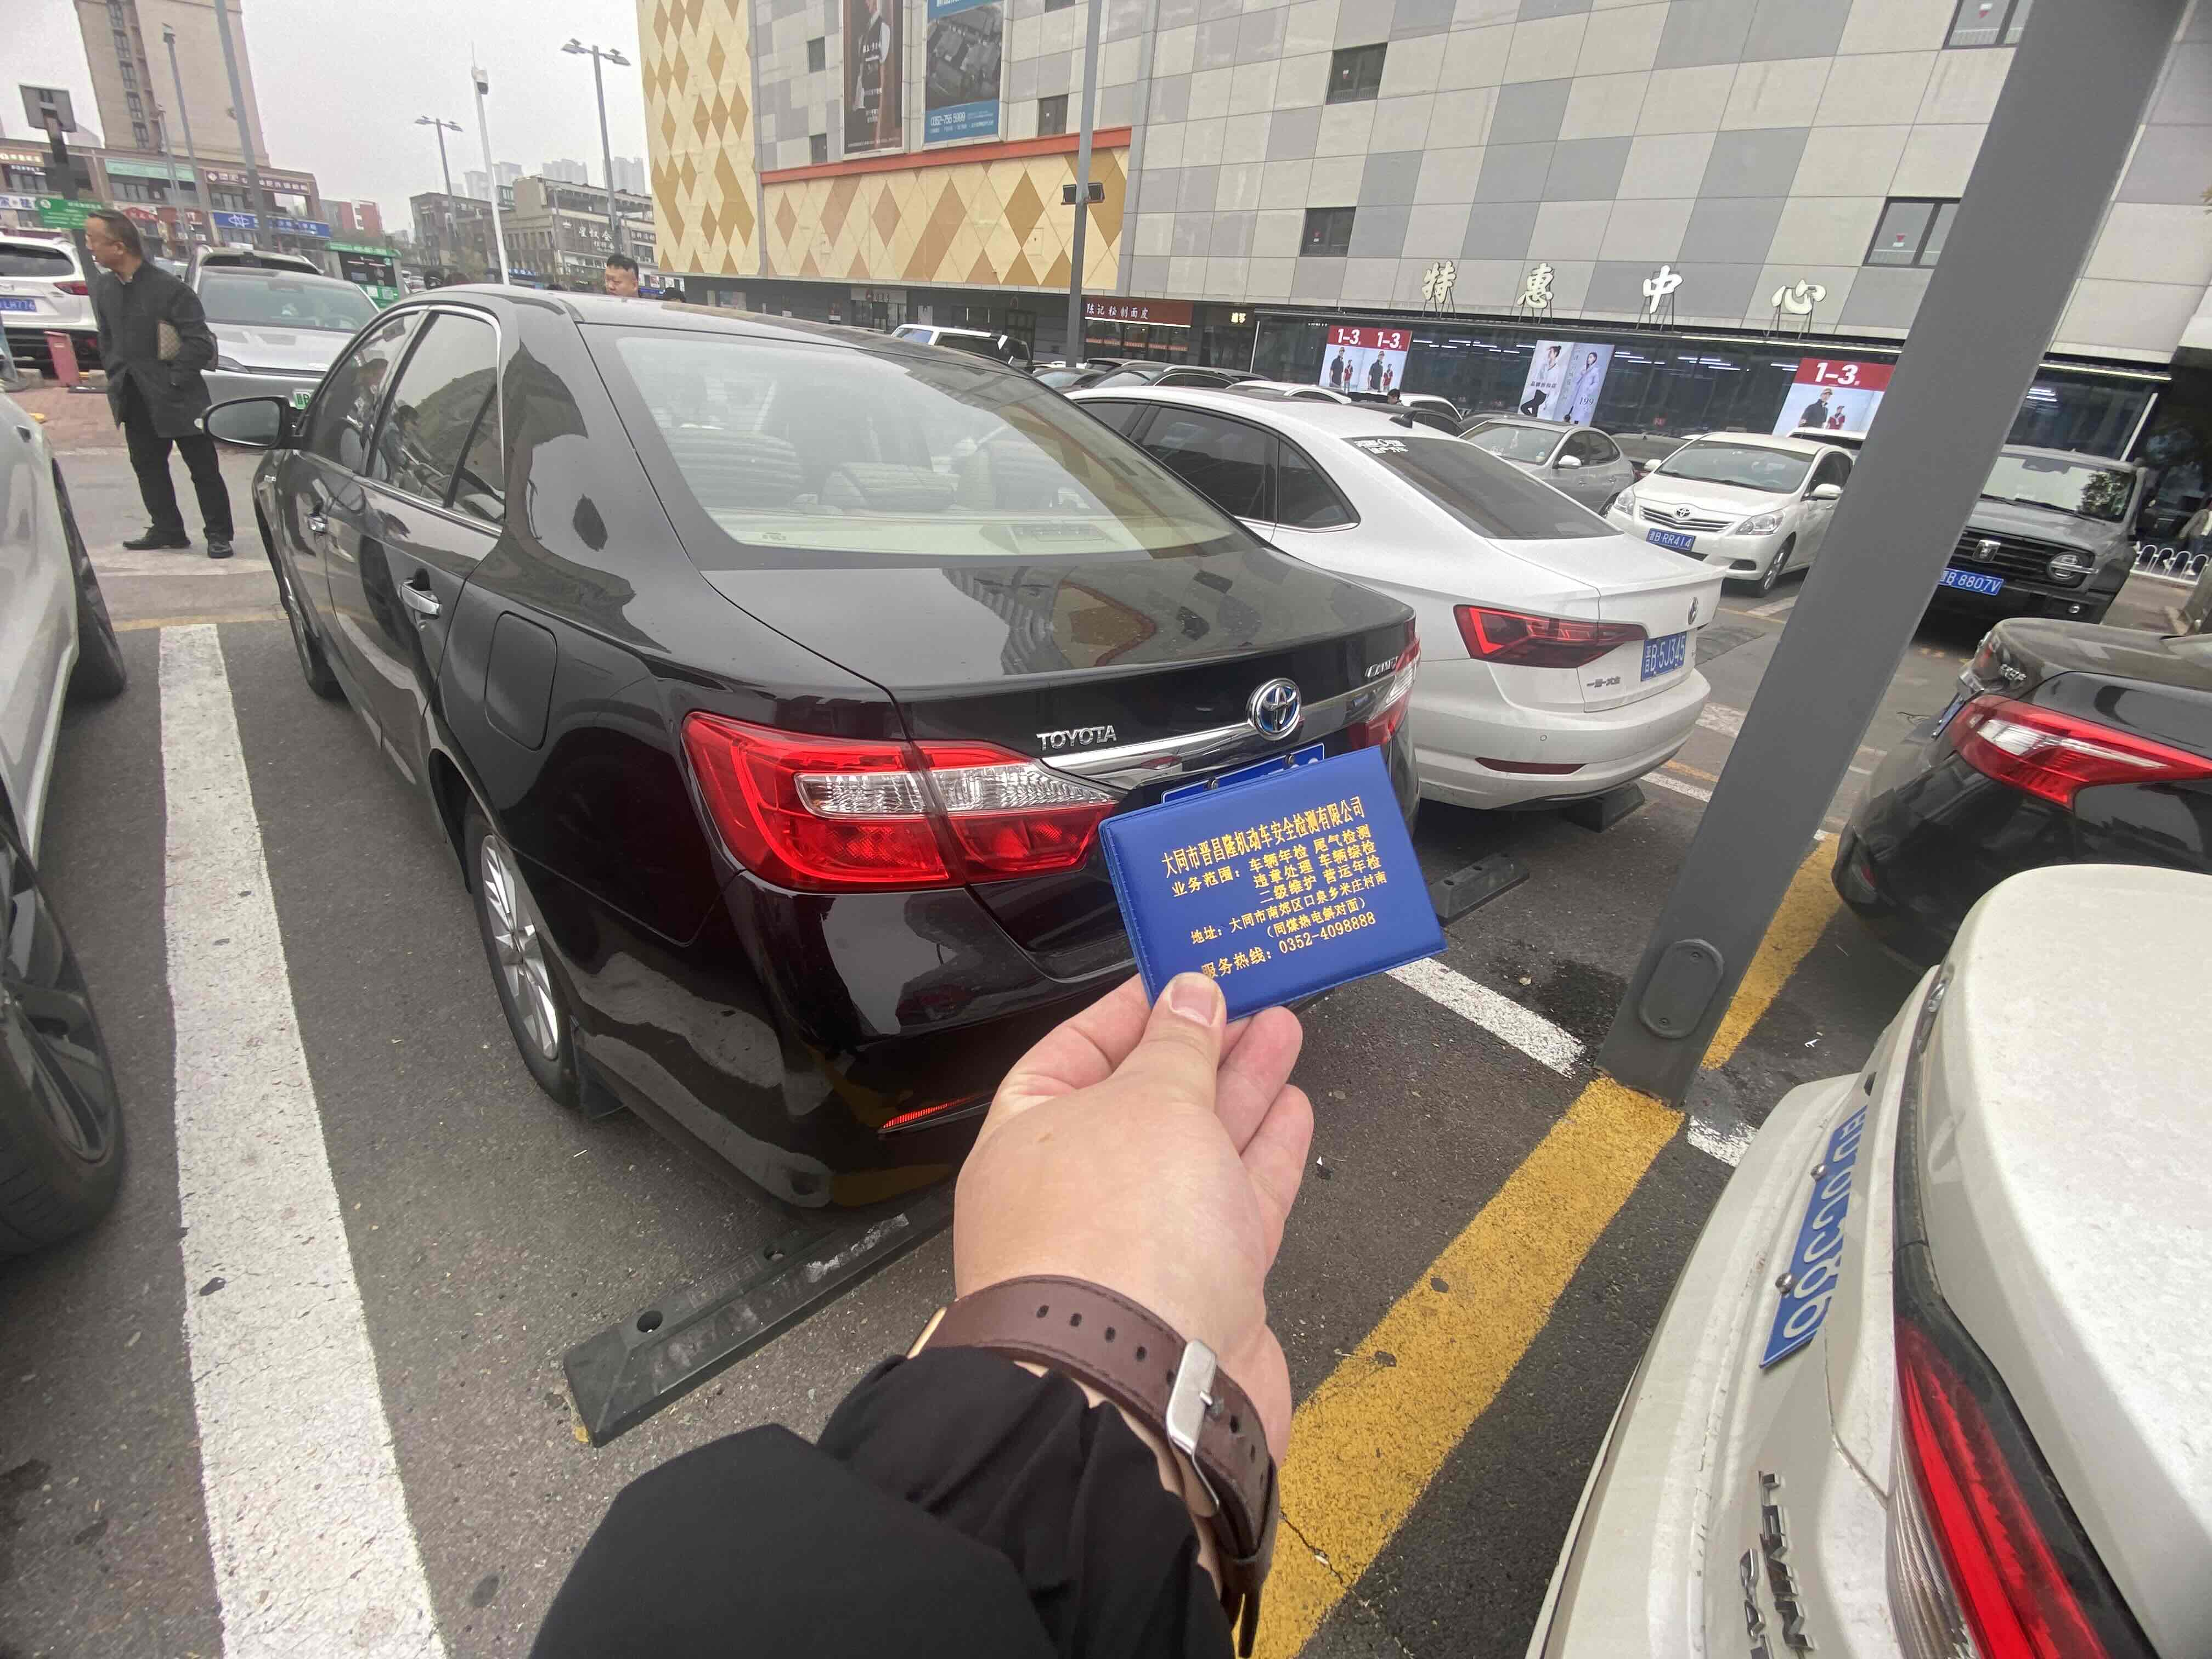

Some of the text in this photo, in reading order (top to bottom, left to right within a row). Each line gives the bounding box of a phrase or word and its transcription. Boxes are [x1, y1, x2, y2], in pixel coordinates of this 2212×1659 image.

[1421, 259, 1826, 315] 特惠中心
[1036, 725, 1117, 751] TOYOTA
[1162, 796, 1365, 878] 大同市晋昌隆机动车安全检测有限公司
[1313, 824, 1372, 854] 尾气检测
[1253, 859, 1314, 888] 违章处理
[1259, 855, 1381, 904] 二级维护 营运年检
[1279, 911, 1376, 953] 0352-4098888
